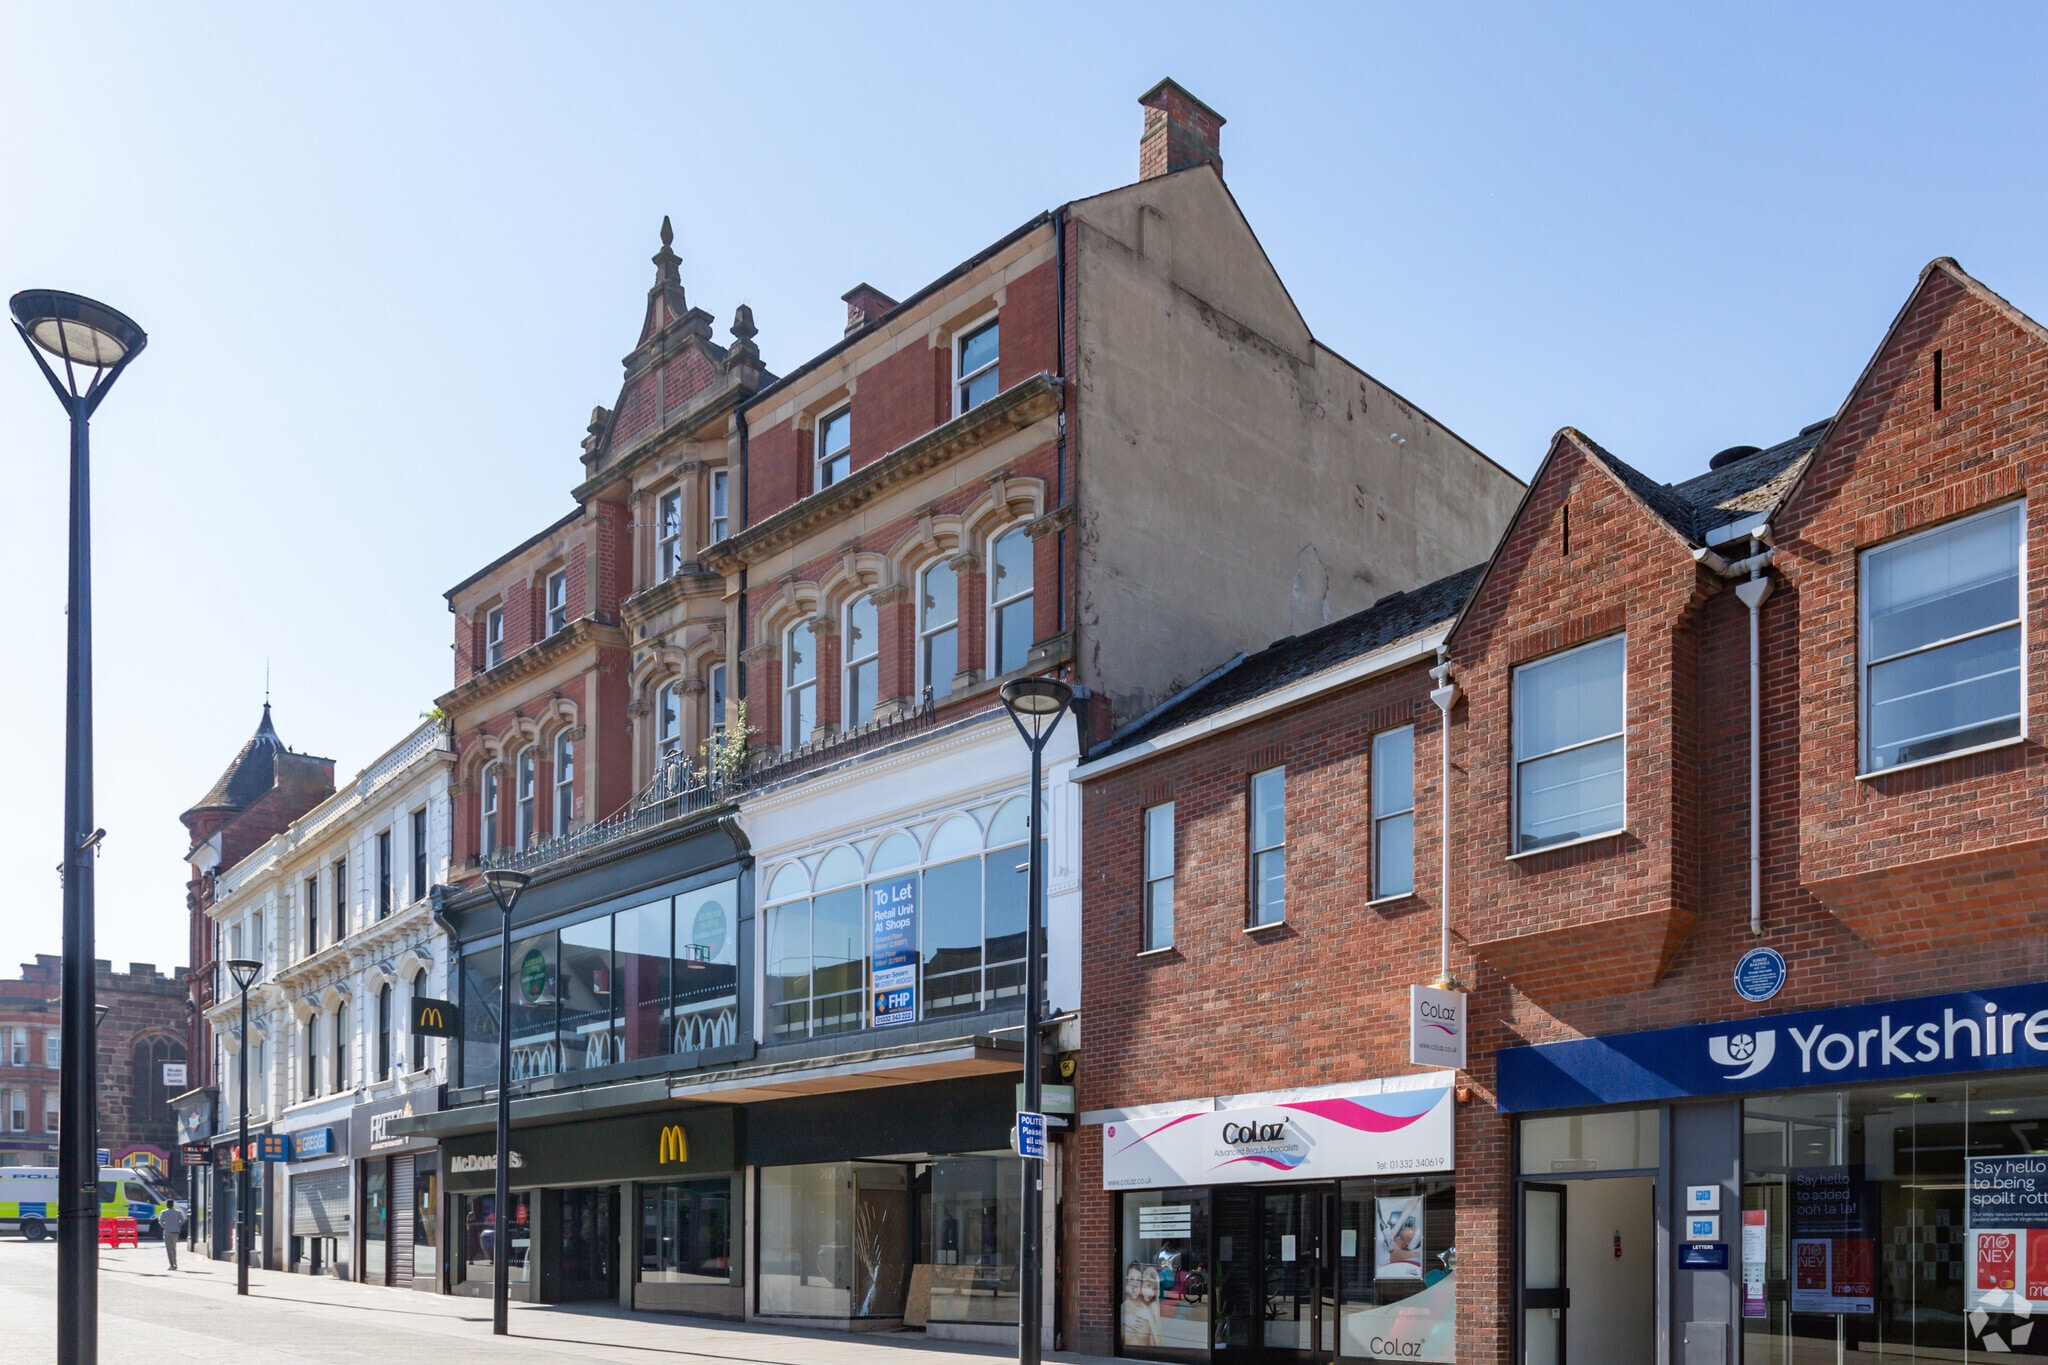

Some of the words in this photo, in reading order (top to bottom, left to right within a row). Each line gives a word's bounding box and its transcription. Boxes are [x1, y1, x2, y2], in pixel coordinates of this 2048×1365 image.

[874, 890, 888, 906] To
[892, 884, 912, 902] Let
[874, 907, 895, 921] Retail
[898, 904, 914, 916] Unit
[874, 922, 883, 933] A1
[886, 918, 910, 930] Shops
[889, 992, 910, 1008] FHP
[1788, 1002, 2048, 1072] Yorkshire
[1021, 1116, 1042, 1126] POLITE
[1022, 1126, 1042, 1136] Please
[302, 1132, 326, 1152] GREGGS
[1214, 1148, 1244, 1156] Advanced
[1246, 1147, 1266, 1155] Beauty
[1268, 1144, 1299, 1153] Specialists
[1377, 1161, 1388, 1170] Tel:
[1390, 1159, 1414, 1169] 01332
[1415, 1158, 1444, 1168] 340619
[1974, 1162, 2002, 1176] Say
[2006, 1160, 2046, 1173] hello
[1797, 1174, 1818, 1187] Say
[1820, 1173, 1850, 1185] hello
[1973, 1178, 1990, 1189] to
[1994, 1177, 2035, 1191] being
[1797, 1192, 1809, 1200] to
[1812, 1188, 1850, 1200] added
[1973, 1192, 2016, 1207] spoilt
[1797, 1204, 1820, 1215] ooh
[1825, 1203, 1836, 1214] la
[1840, 1202, 1857, 1214] la!
[1799, 1257, 1824, 1268] NEY
[1979, 1250, 2014, 1262] NEY
[1835, 1285, 1870, 1293] MONEY
